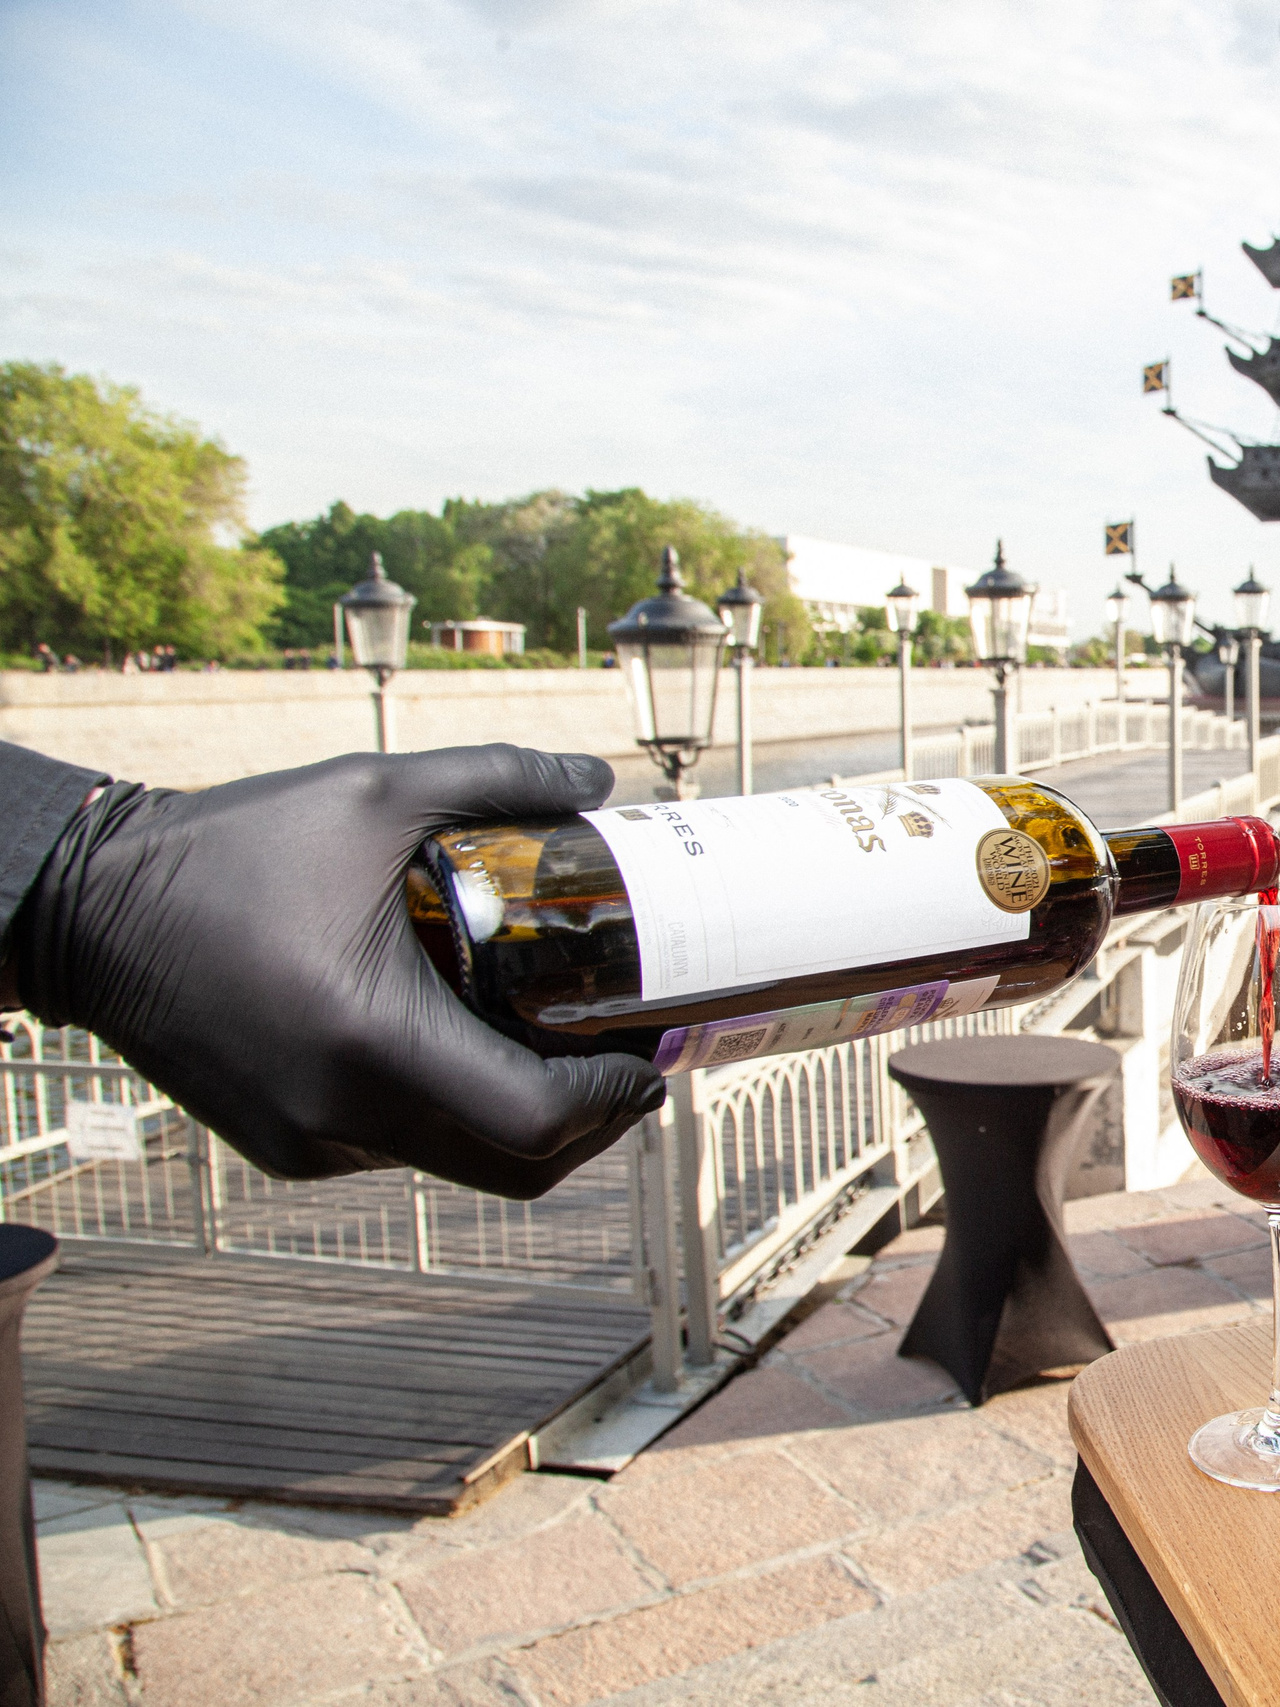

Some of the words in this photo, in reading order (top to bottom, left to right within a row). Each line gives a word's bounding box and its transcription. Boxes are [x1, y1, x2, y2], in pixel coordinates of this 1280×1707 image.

[820, 789, 887, 852] onas
[990, 851, 1005, 891] WORLD
[1000, 836, 1028, 903] WINE
[1013, 835, 1026, 857] MOST
[1021, 859, 1034, 901] ADMIRED
[1024, 843, 1035, 865] THE
[1030, 866, 1040, 889] 2021
[1194, 836, 1207, 886] TORRES
[668, 920, 689, 979] CATALUNYA
